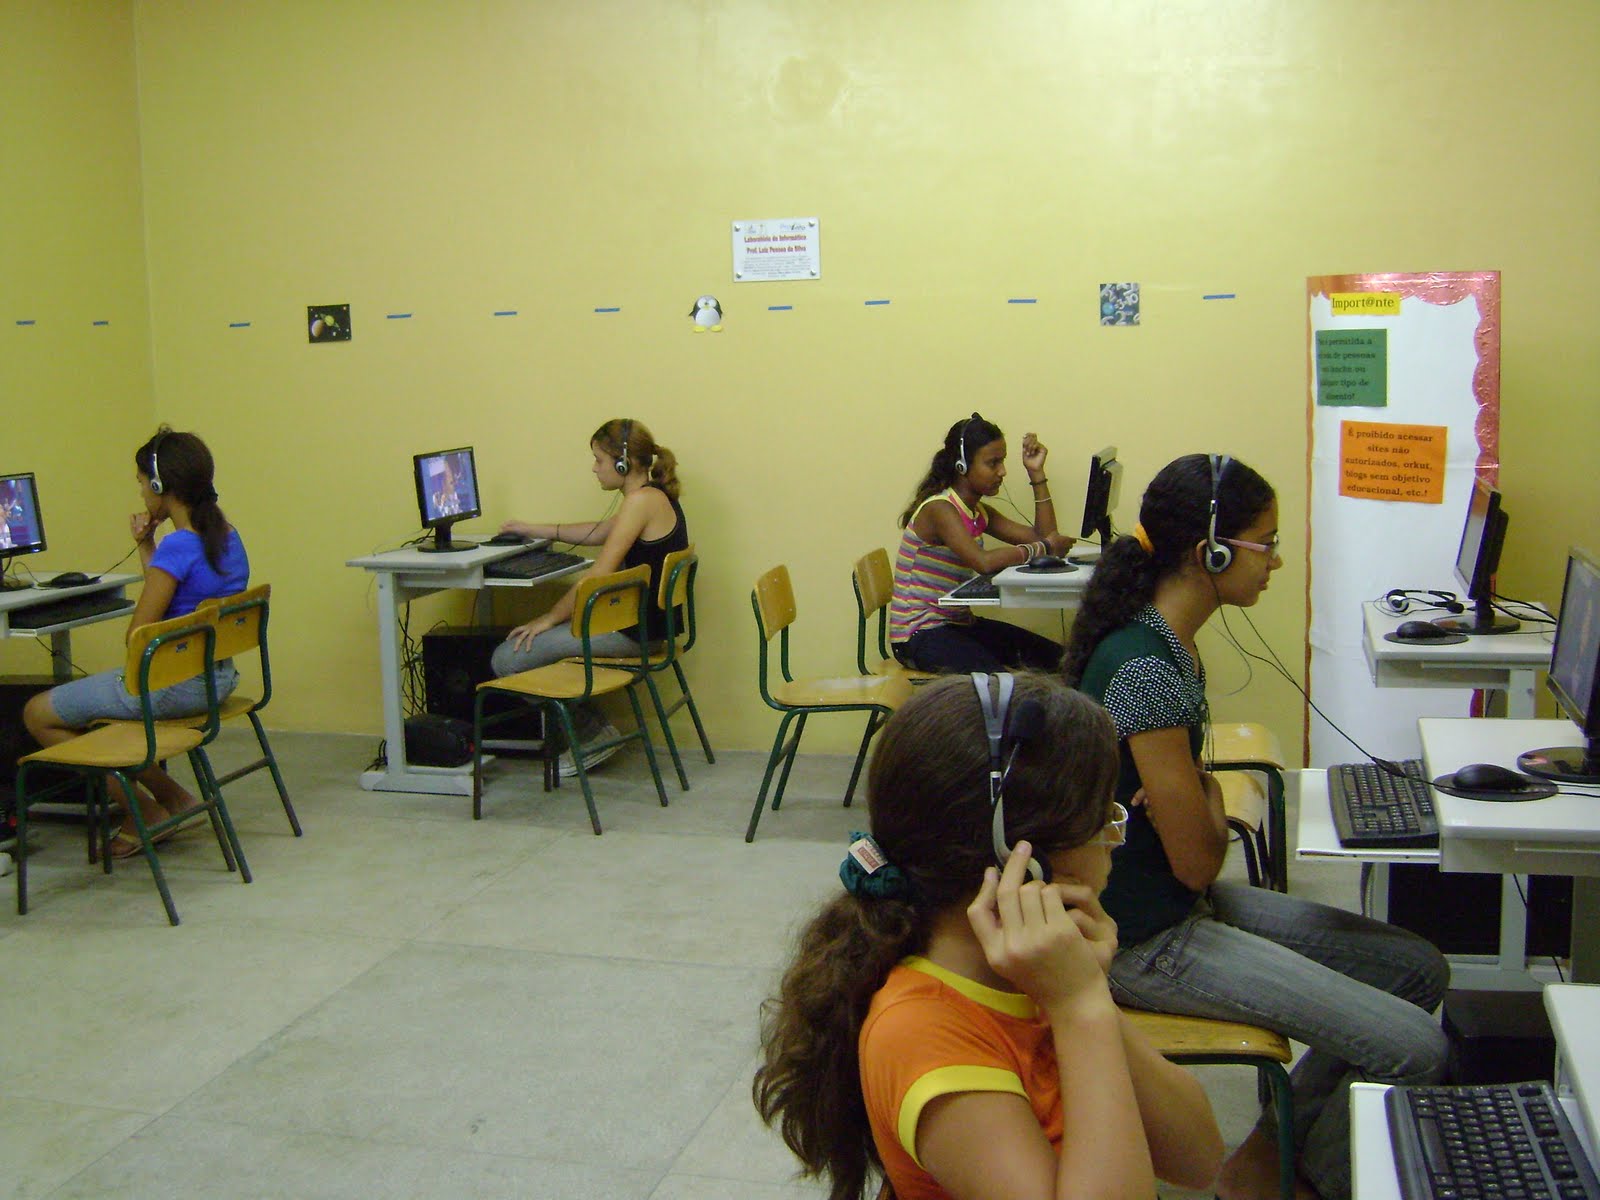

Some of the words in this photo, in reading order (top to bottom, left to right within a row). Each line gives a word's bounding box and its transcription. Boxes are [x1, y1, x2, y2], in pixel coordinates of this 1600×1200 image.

[1332, 296, 1395, 311] Import@nte
[1348, 427, 1354, 437] É
[1356, 429, 1395, 440] proibido
[1397, 433, 1433, 442] acessar
[1367, 444, 1389, 453] sites
[1392, 446, 1410, 454] não
[1403, 461, 1433, 470] orkut,
[1345, 470, 1368, 481] blogs
[1370, 473, 1389, 481] sem
[1391, 473, 1431, 484] objetivo
[1347, 484, 1403, 496] educacional,
